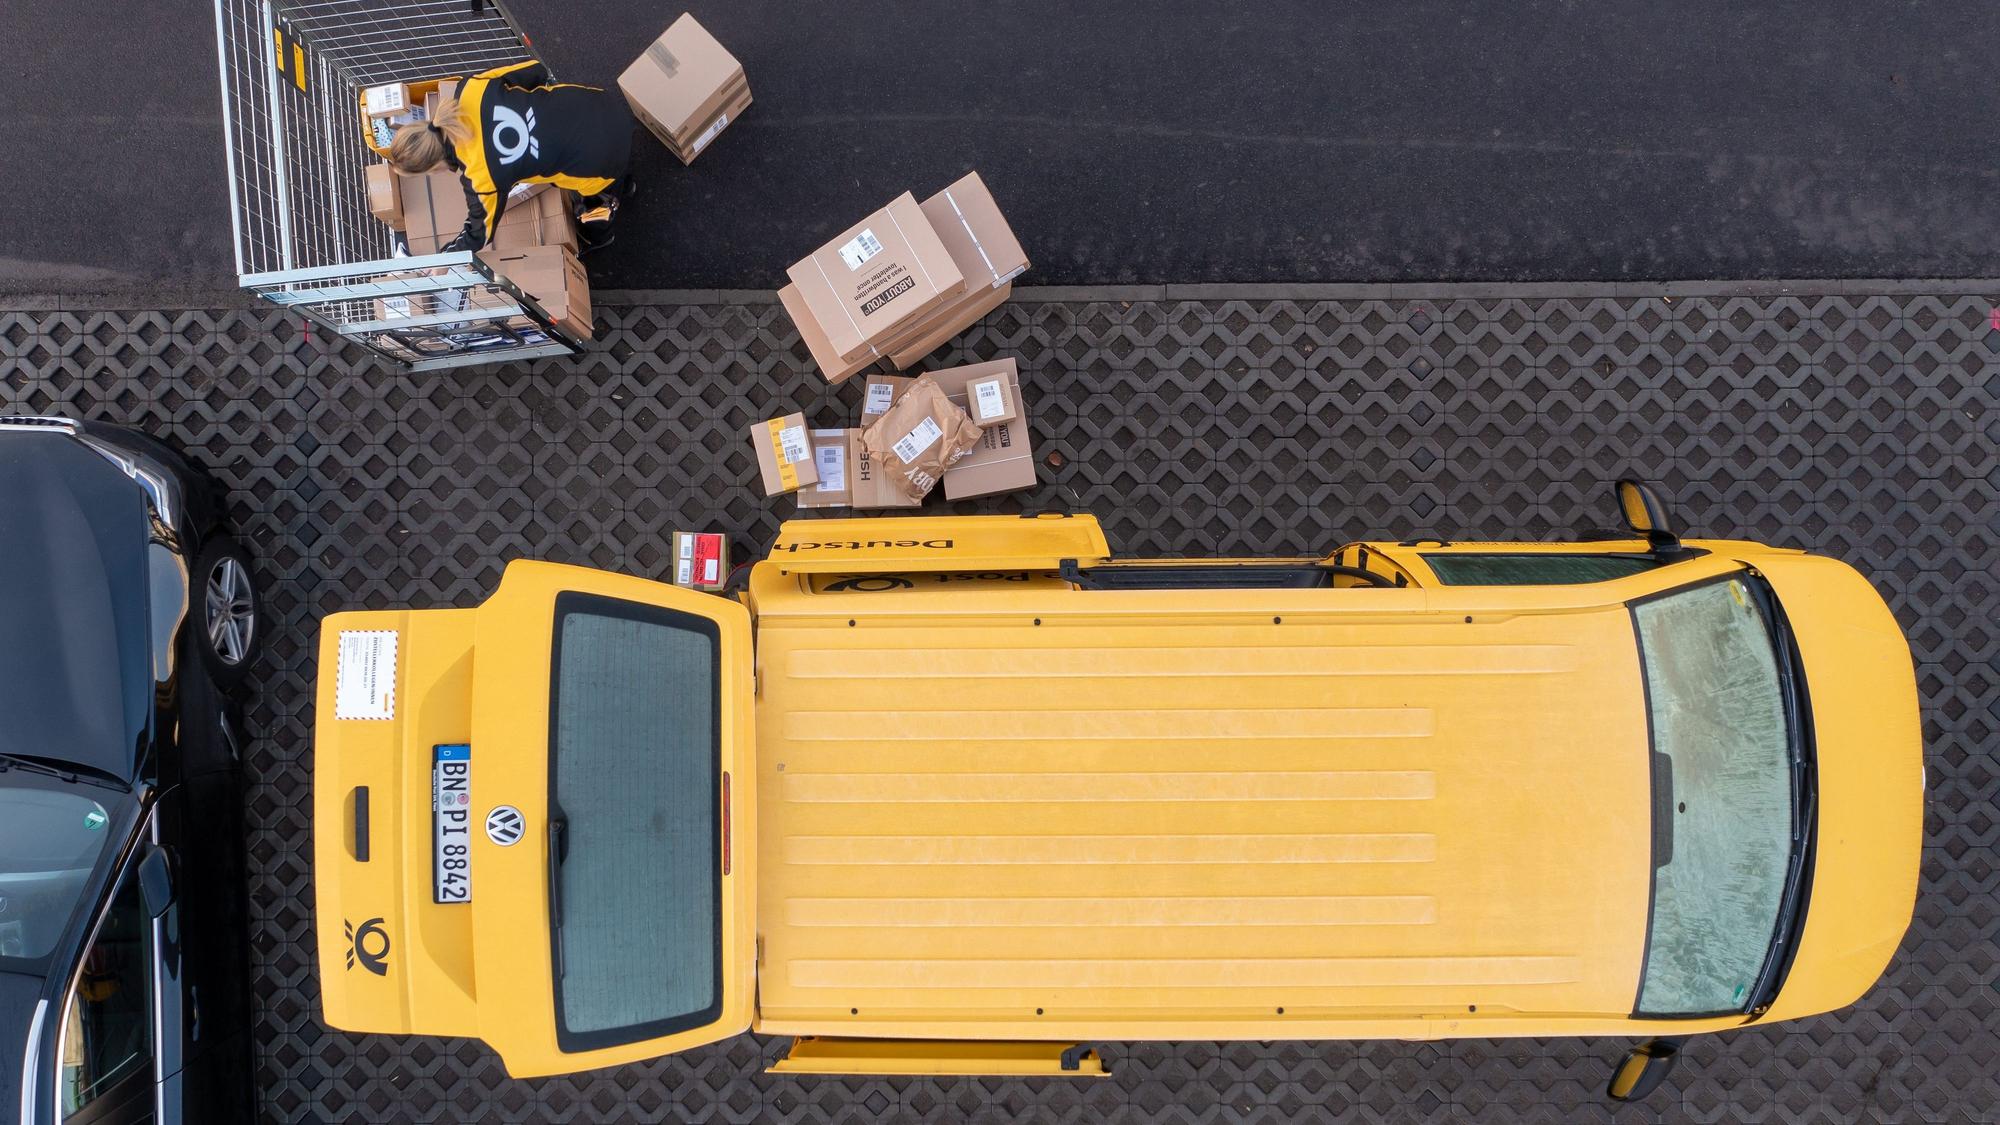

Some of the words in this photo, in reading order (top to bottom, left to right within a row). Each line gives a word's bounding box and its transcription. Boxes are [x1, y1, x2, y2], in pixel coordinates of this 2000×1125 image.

[870, 262, 898, 283] loveletter
[891, 267, 904, 278] was
[854, 277, 888, 302] handwritten
[882, 276, 914, 302] ABOUT
[860, 453, 870, 481] HSE
[774, 539, 954, 553] Deutsch
[934, 572, 1030, 583] Post
[442, 762, 467, 791] BN
[442, 809, 467, 837] PI
[442, 844, 467, 899] 8842
